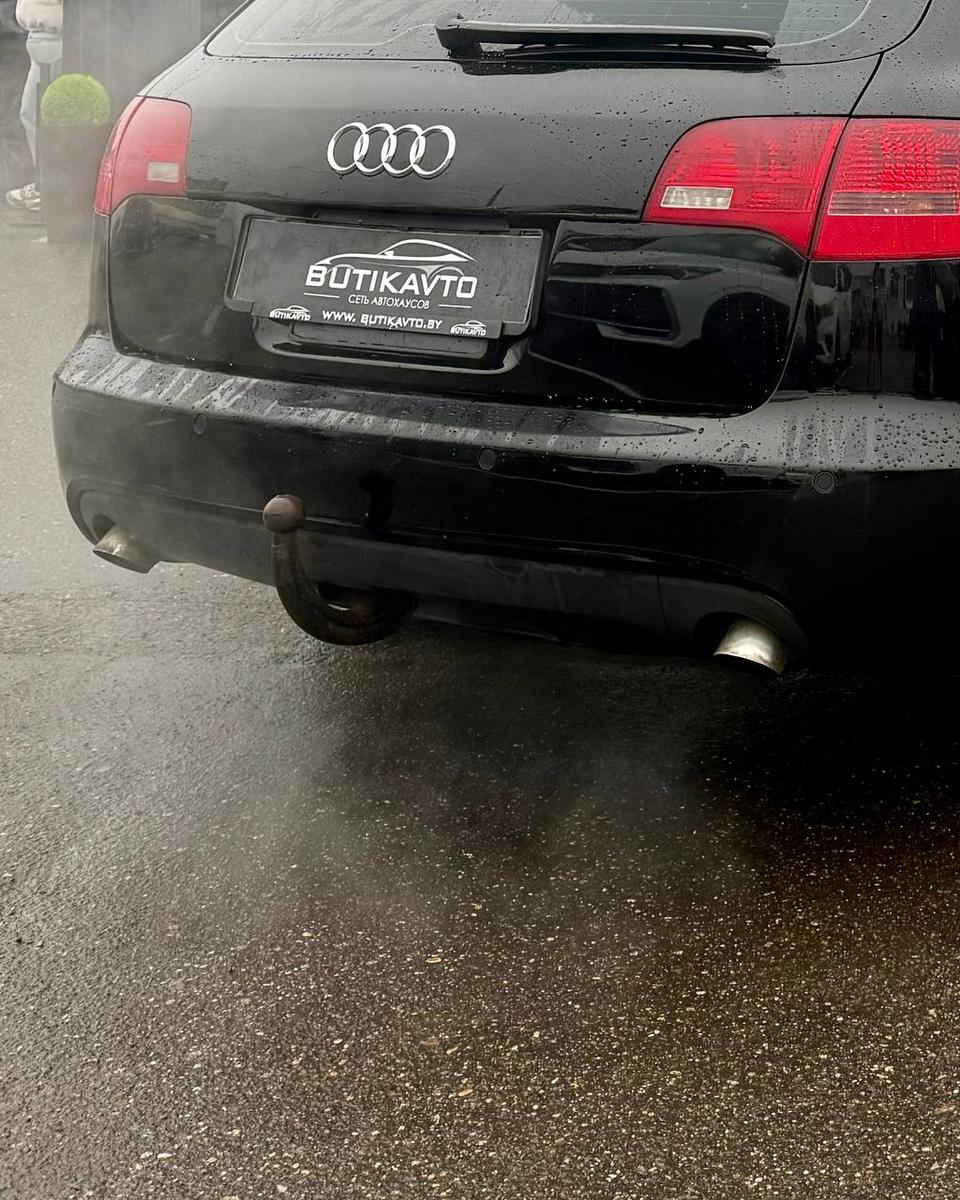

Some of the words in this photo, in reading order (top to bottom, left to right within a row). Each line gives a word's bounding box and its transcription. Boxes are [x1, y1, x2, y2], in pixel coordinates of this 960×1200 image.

[305, 264, 478, 299] BUTIKAVTO
[348, 294, 370, 305] СЕТЬ
[371, 296, 430, 309] АВТОХАУСОВ
[322, 310, 357, 322] WWW.
[360, 313, 443, 330] BUTIKAVTO.BY
